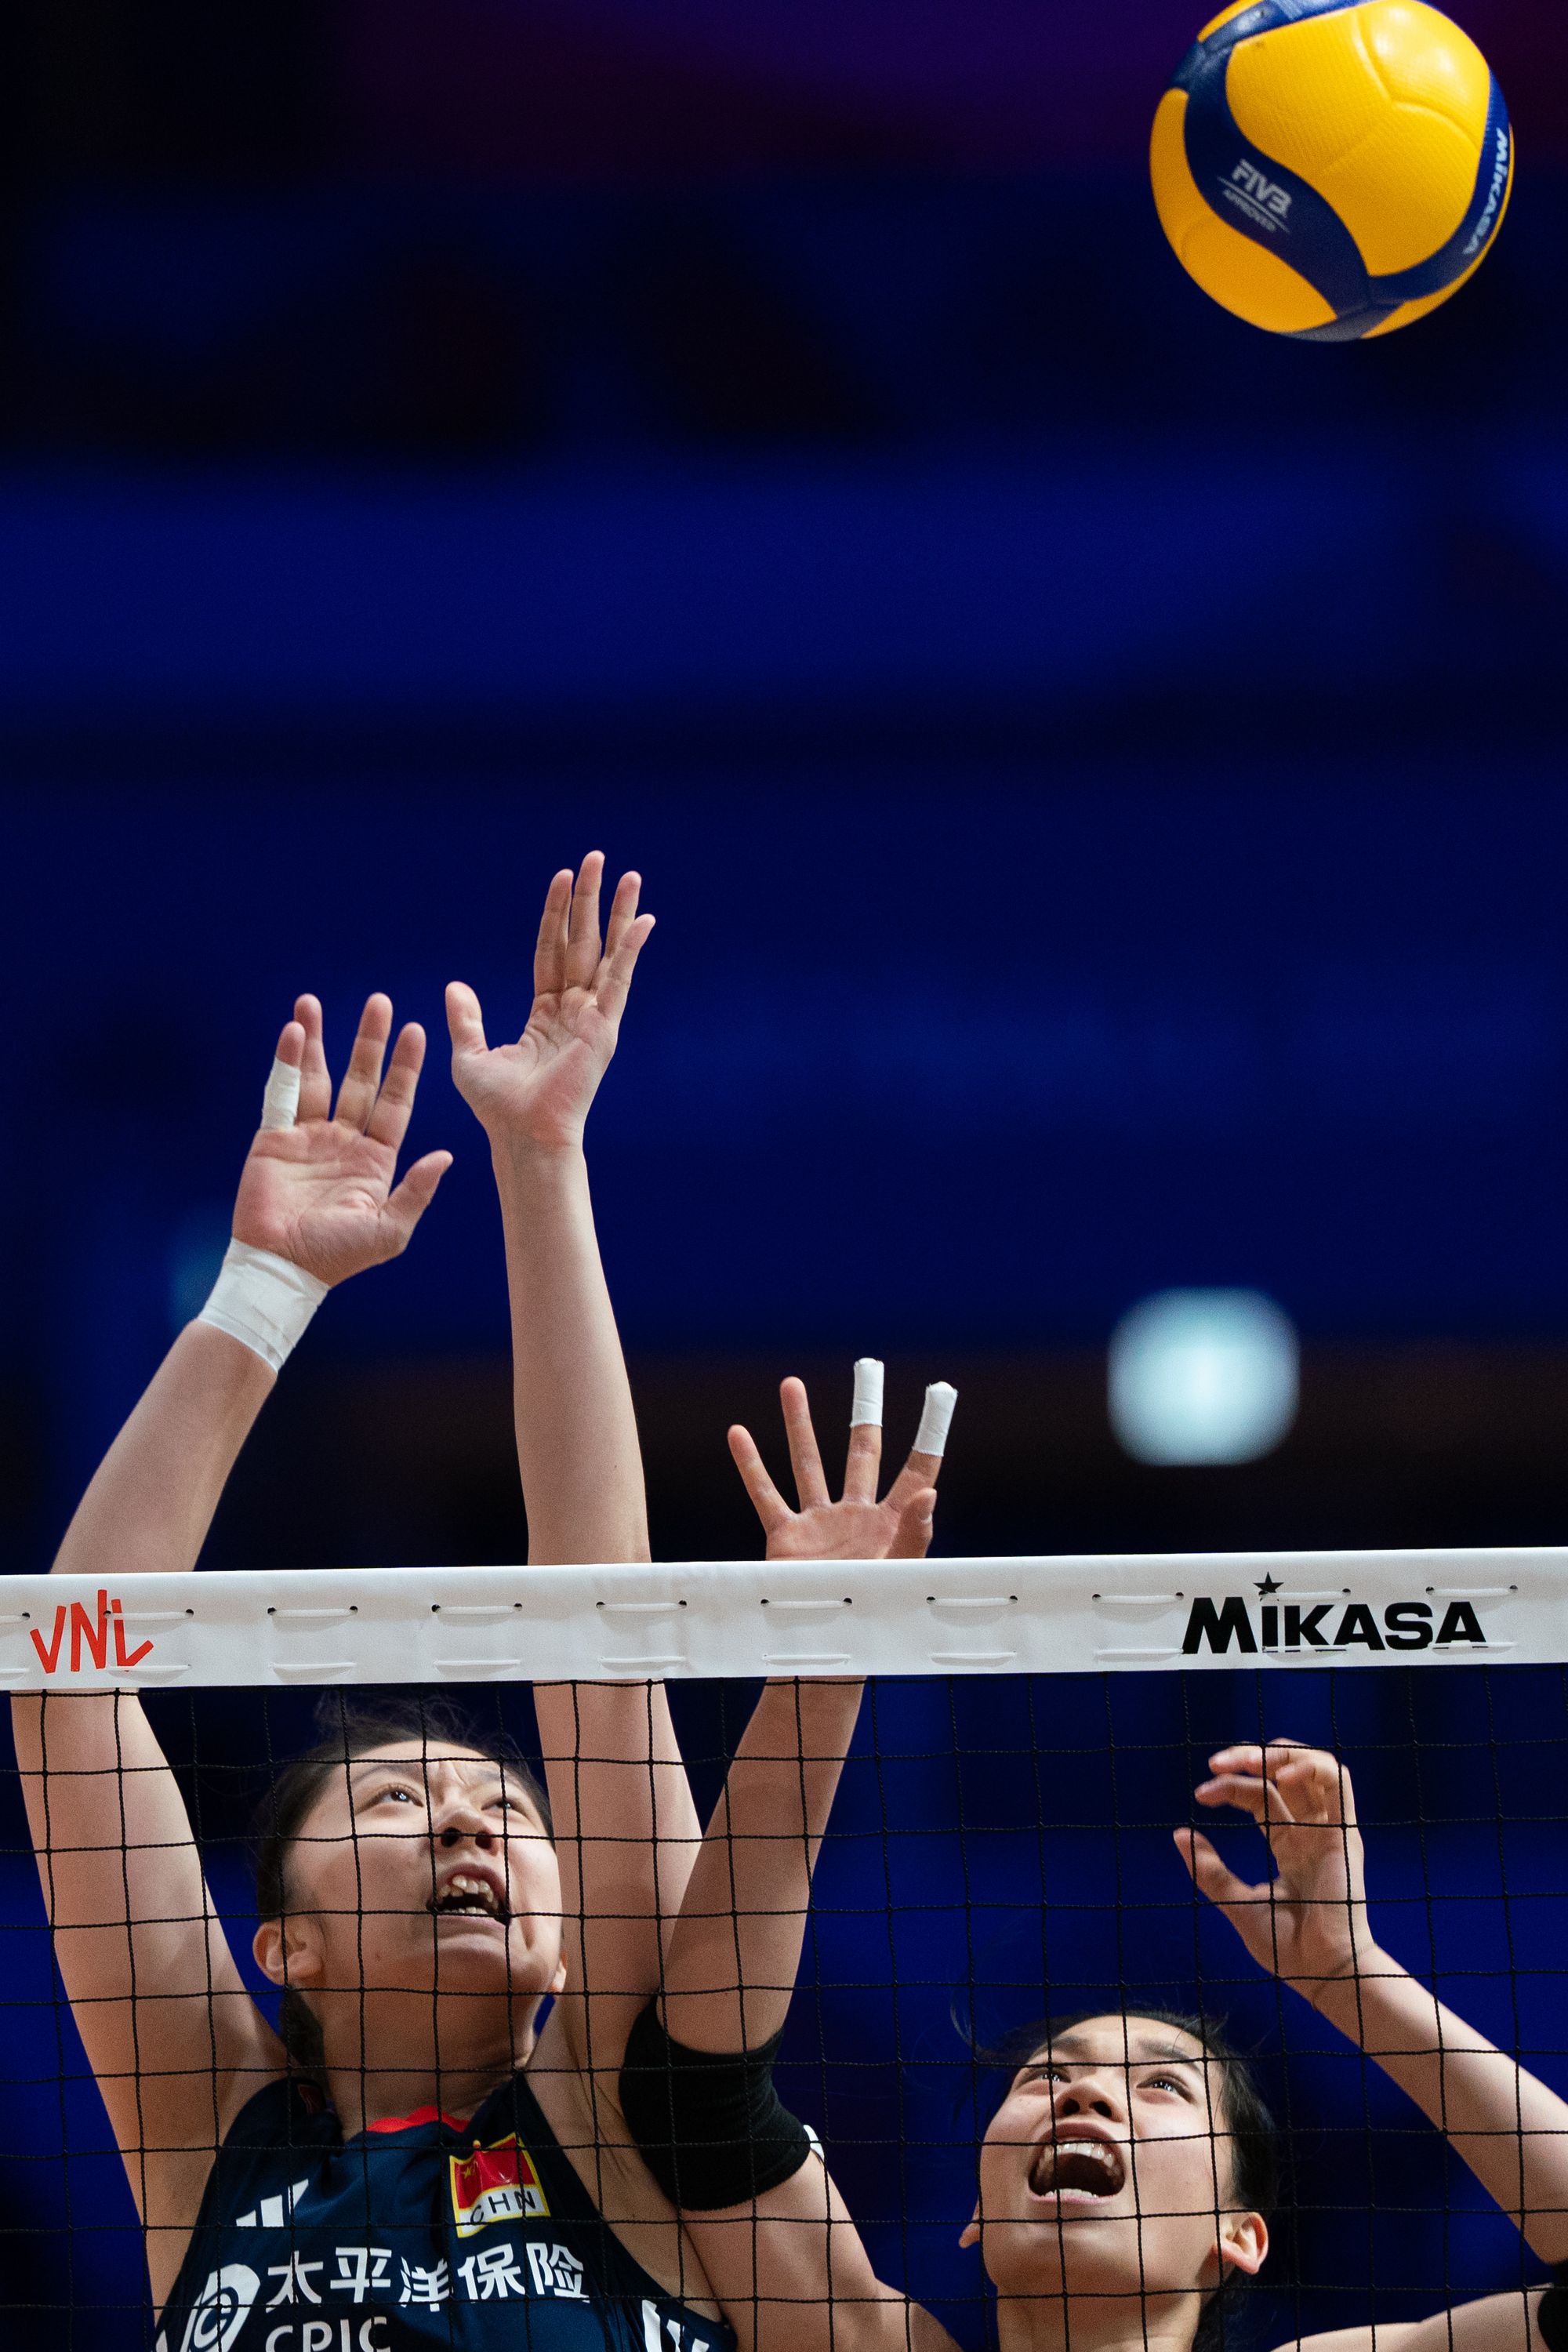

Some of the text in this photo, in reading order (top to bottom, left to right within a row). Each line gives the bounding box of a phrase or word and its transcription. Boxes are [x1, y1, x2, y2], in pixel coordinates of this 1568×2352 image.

[1462, 127, 1508, 255] MIKASA
[31, 1589, 154, 1673] VNL
[1182, 1572, 1488, 1653] MIKASA
[470, 2190, 536, 2225] CHN
[266, 2242, 590, 2313] 太平洋保险
